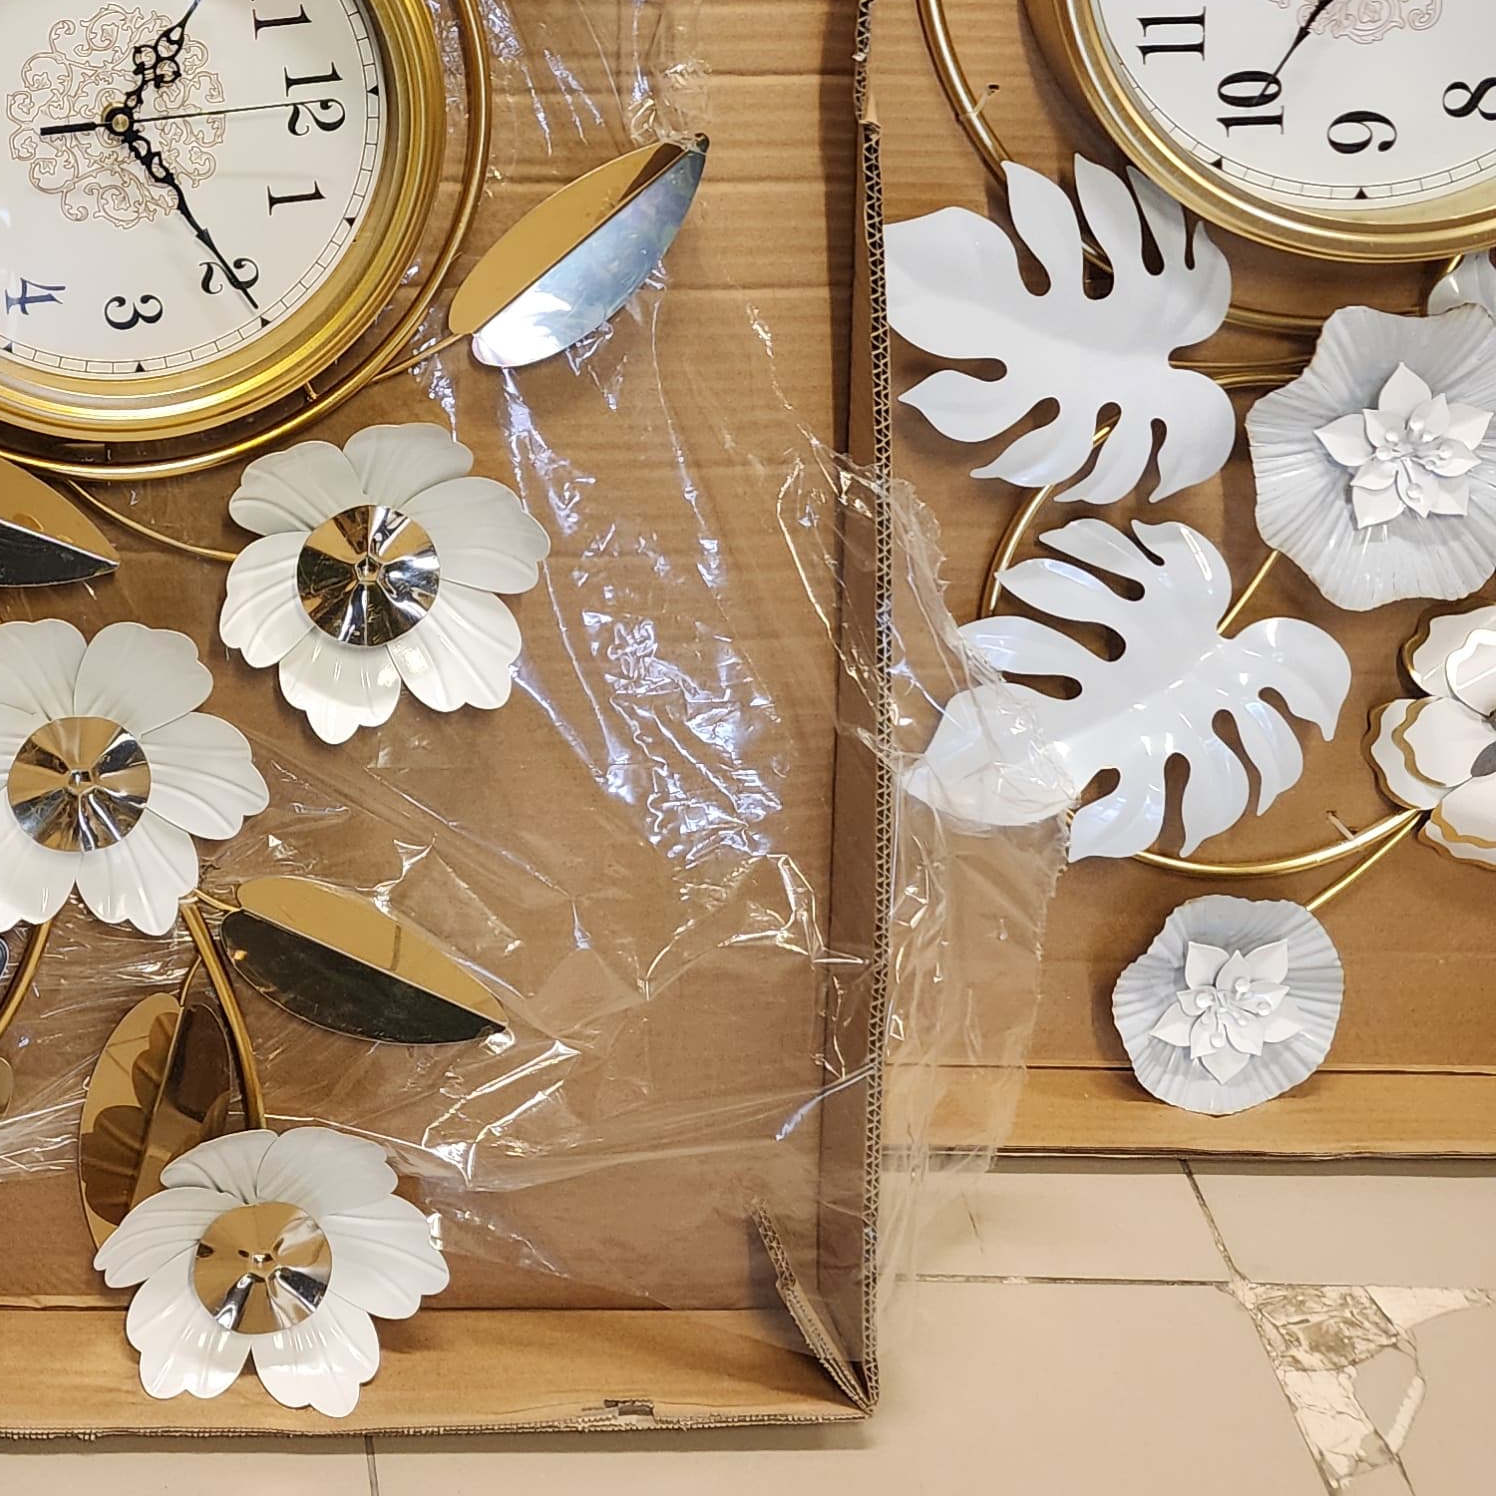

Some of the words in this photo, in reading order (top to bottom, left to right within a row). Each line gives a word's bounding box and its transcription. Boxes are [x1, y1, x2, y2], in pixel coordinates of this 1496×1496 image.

[1136, 6, 1205, 64] 11
[284, 62, 345, 136] 12
[1216, 70, 1284, 137] 10
[1327, 110, 1396, 154] 9
[267, 181, 326, 215] 1
[5, 277, 66, 315] 4
[199, 258, 259, 295] 2
[104, 294, 162, 330] 3
